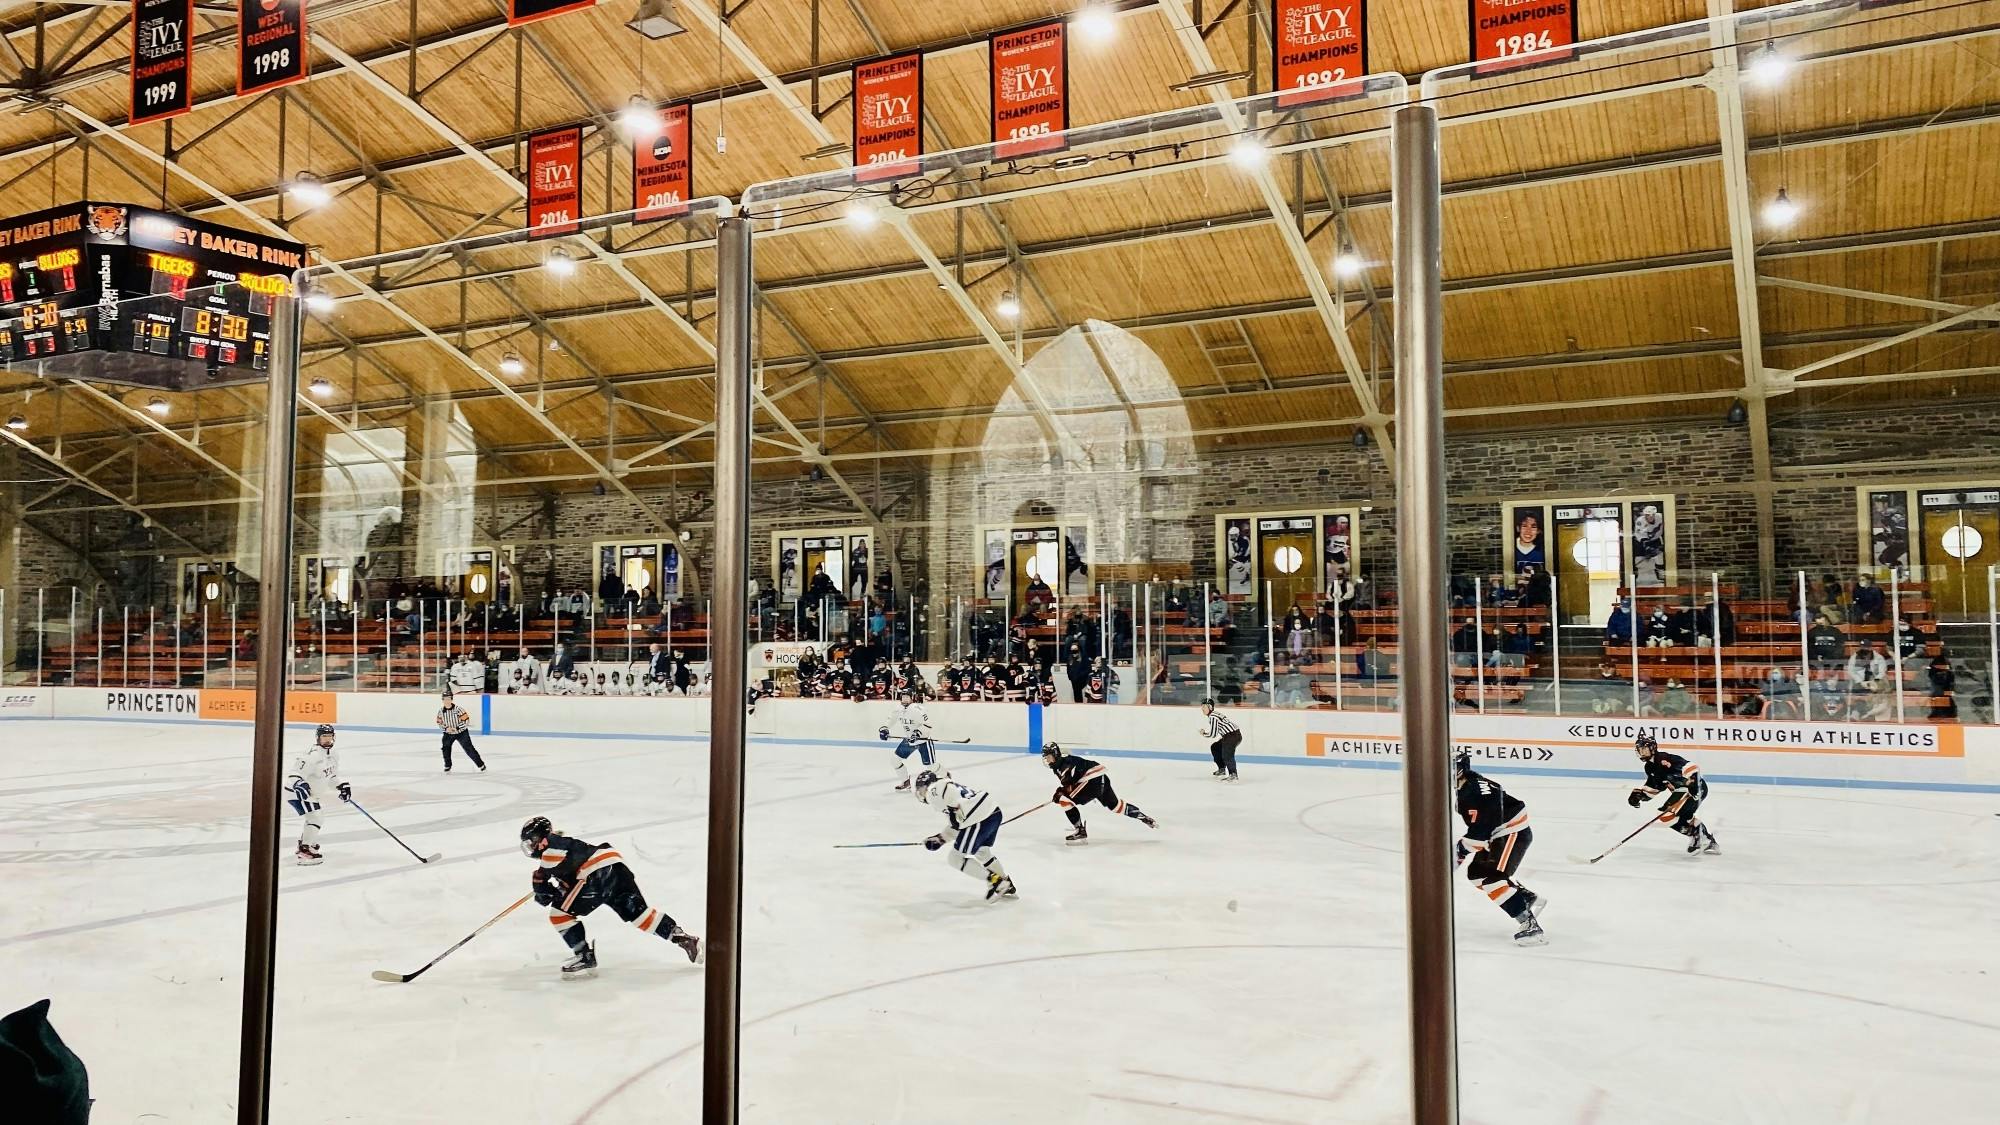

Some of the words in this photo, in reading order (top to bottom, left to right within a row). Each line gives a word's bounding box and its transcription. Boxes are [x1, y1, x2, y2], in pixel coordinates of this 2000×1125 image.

[258, 10, 285, 28] WEST
[1303, 4, 1321, 14] THE
[1480, 3, 1566, 29] CHAMPIONS
[1304, 6, 1352, 35] IVY
[150, 20, 183, 48] IVY
[247, 23, 295, 47] REGIONAL
[997, 27, 1060, 50] PRINCETON
[1304, 28, 1352, 45] LEAGUE
[1496, 30, 1552, 57] 1984
[150, 42, 184, 59] LEAGUE
[1282, 43, 1358, 66] CHAMPIONS
[136, 57, 185, 79] CHAMPIONS
[254, 48, 290, 75] 1998
[859, 59, 917, 79] PRINCETON
[1016, 63, 1031, 72] THE
[1016, 66, 1056, 92] IVY
[145, 81, 177, 106] 1999
[1016, 86, 1056, 102] LEAGUE
[876, 95, 912, 119] IVY
[999, 100, 1060, 120] CHAMPIONS
[875, 114, 913, 129] LEAGUE
[859, 127, 916, 146] CHAMPIONS
[545, 163, 574, 184] IVY
[638, 160, 687, 177] MINNESOTA
[641, 172, 683, 187] REGIONAL
[647, 191, 680, 208] 2006
[14, 221, 50, 244] BAKER
[52, 213, 81, 235] RINK
[540, 210, 570, 228] 2016
[201, 232, 258, 260] BAKER
[262, 247, 301, 268] RINK
[151, 255, 194, 277] TIGERS
[207, 269, 236, 282] PERIOD
[195, 310, 249, 342] 8:30
[107, 692, 197, 713] PRINCETON
[208, 700, 246, 712] ACHIEVE
[298, 702, 324, 714] LEAD
[1585, 725, 1695, 740] EDUCATION
[1704, 727, 1802, 743] THROUGH
[1812, 731, 1934, 747] ATHLETICS
[1330, 741, 1403, 755] ACHIEVE
[1486, 746, 1532, 760] LEAD
[1468, 809, 1478, 823] 7
